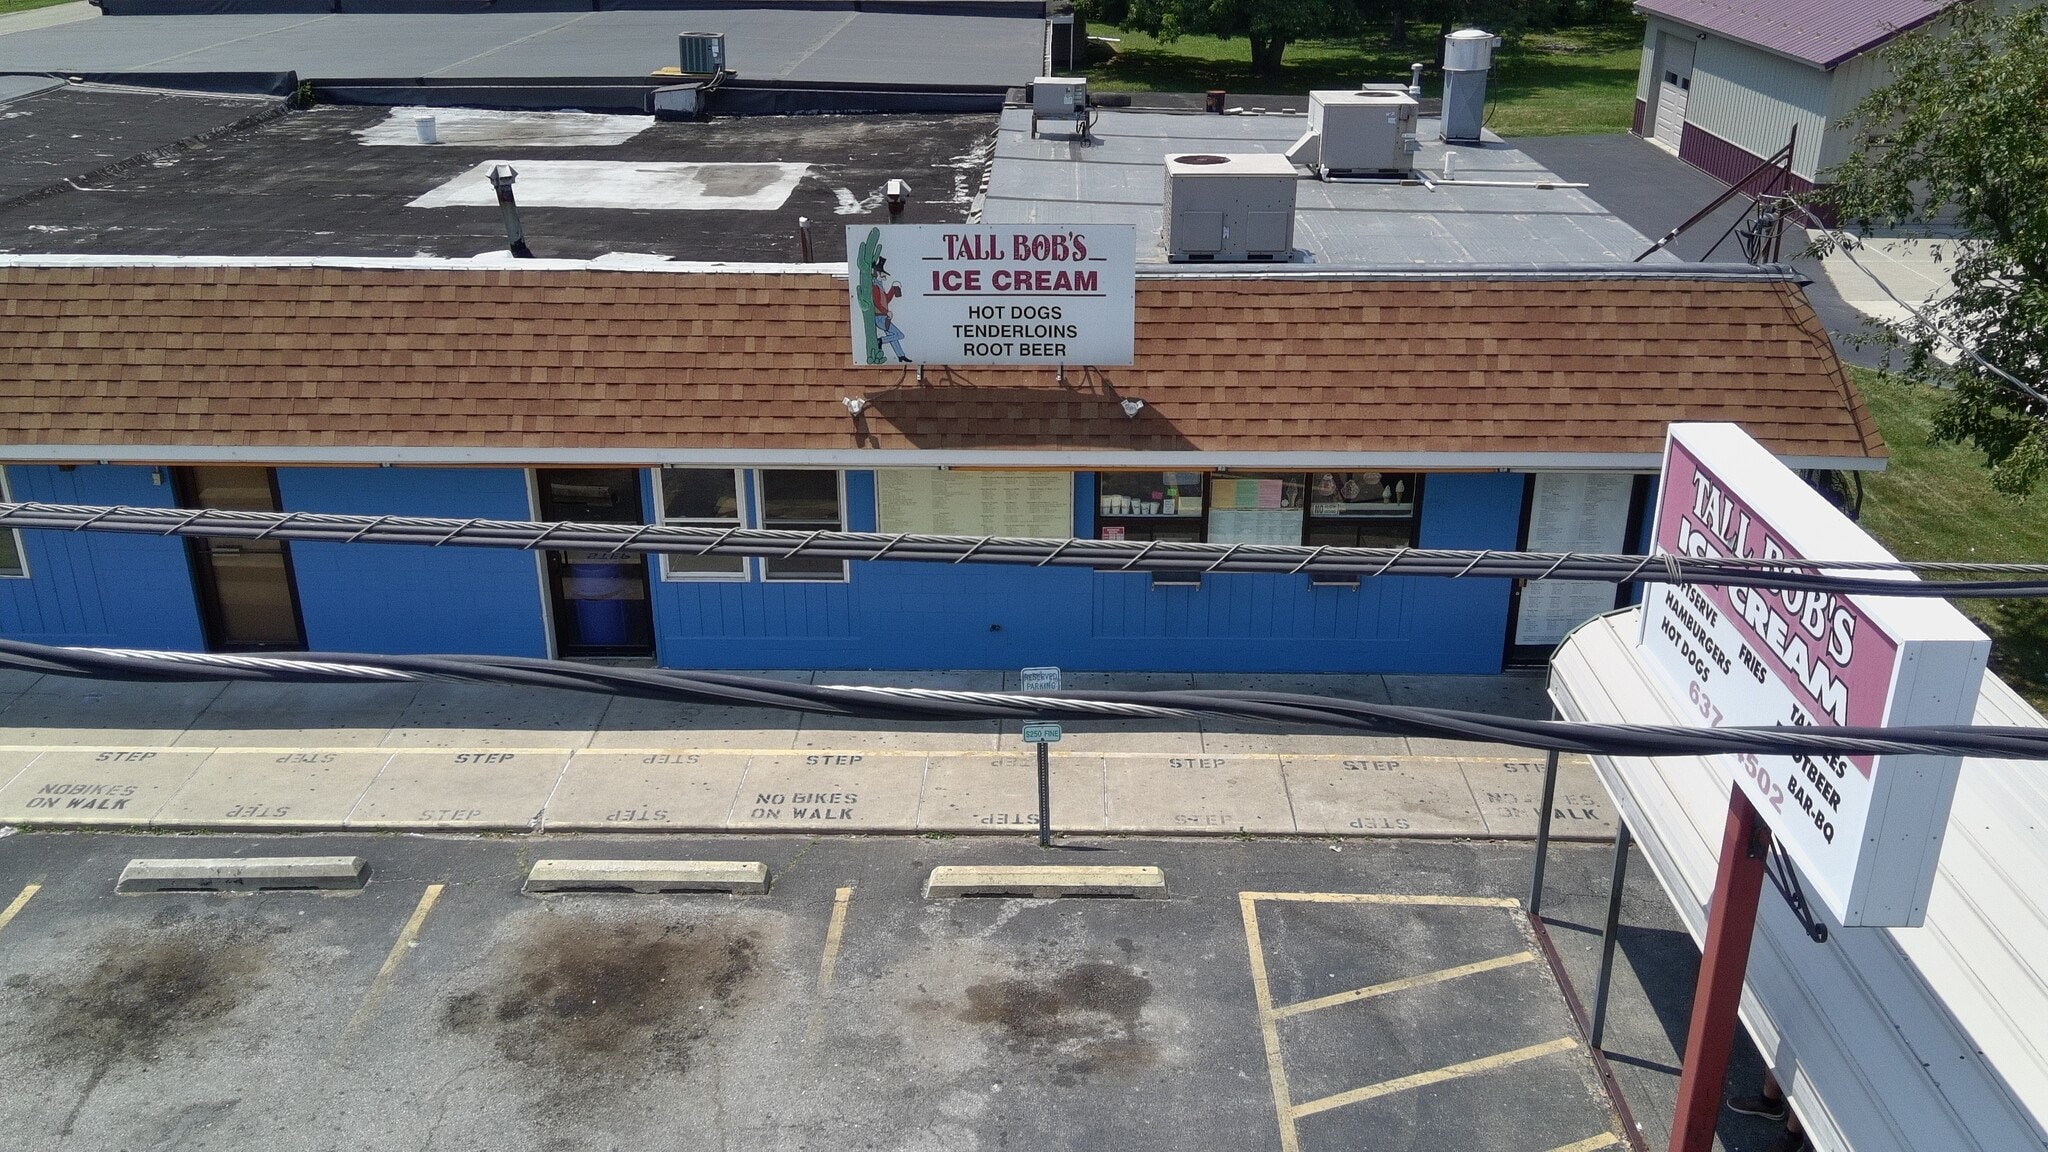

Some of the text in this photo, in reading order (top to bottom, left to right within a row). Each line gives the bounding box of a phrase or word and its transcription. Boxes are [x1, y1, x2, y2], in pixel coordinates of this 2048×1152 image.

[943, 232, 1089, 261] TALL BOB'S
[932, 270, 1098, 291] ICE CREAM
[968, 306, 1062, 320] HOT DOGS
[953, 325, 1078, 339] TENDERLOINS
[964, 343, 1066, 356] ROOT BEER
[1692, 464, 1754, 560] TALL
[1665, 589, 1731, 675] HAMBURGERS
[1738, 643, 1767, 684] FRIES
[1661, 616, 1710, 682] HOT DOGS
[1727, 583, 1849, 730] CREAM
[1025, 673, 1058, 681] RESERVED
[1026, 682, 1056, 690] PARKING
[1026, 730, 1042, 738] $250
[95, 752, 157, 762] STEP
[275, 753, 337, 764] STEP
[454, 753, 515, 764] STEP
[642, 754, 700, 765] STEP
[806, 755, 863, 766] STEP
[1169, 758, 1225, 769] STEP
[1343, 760, 1400, 771] STEP
[1503, 763, 1546, 773] STE
[25, 797, 133, 810] ON WALK
[755, 792, 858, 805] NO BIKES
[226, 805, 290, 817] STEP
[418, 809, 481, 821] STEP
[605, 809, 669, 821] STEP
[751, 808, 853, 820] ON WALK
[1787, 774, 1834, 846] BAR-BQ
[1350, 818, 1411, 830] STEP
